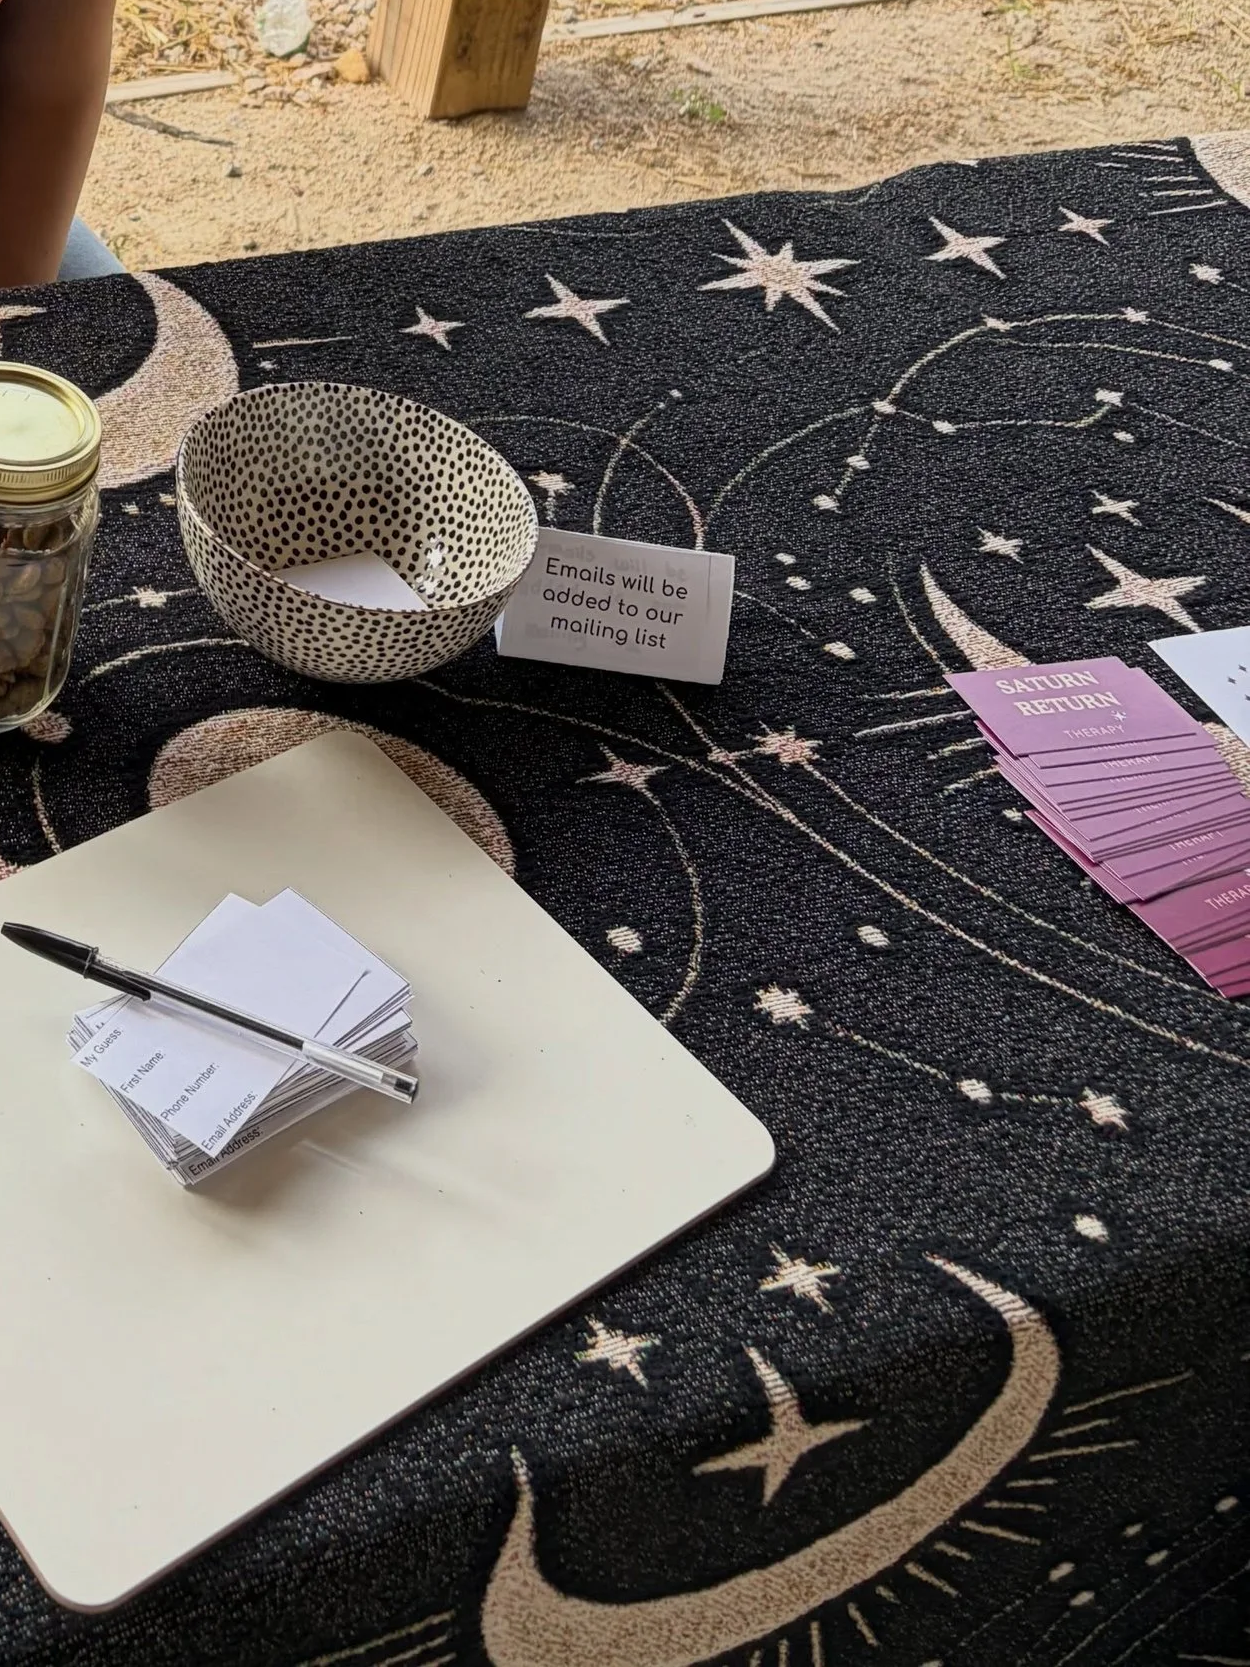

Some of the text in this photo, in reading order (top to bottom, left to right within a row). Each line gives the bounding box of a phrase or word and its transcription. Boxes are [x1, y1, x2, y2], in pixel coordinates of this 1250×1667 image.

[545, 557, 615, 586] Emails
[622, 575, 655, 594] will
[662, 579, 688, 600] be
[543, 588, 684, 626] added to our
[550, 615, 667, 650] mailing list
[995, 671, 1100, 696] SATURN
[1012, 691, 1121, 717] RETURN
[1064, 724, 1126, 739] THERAPY
[79, 1053, 99, 1068] My
[119, 1049, 166, 1094] First Name:
[160, 1062, 220, 1122] Phone Number:
[201, 1090, 259, 1151] Email Address:
